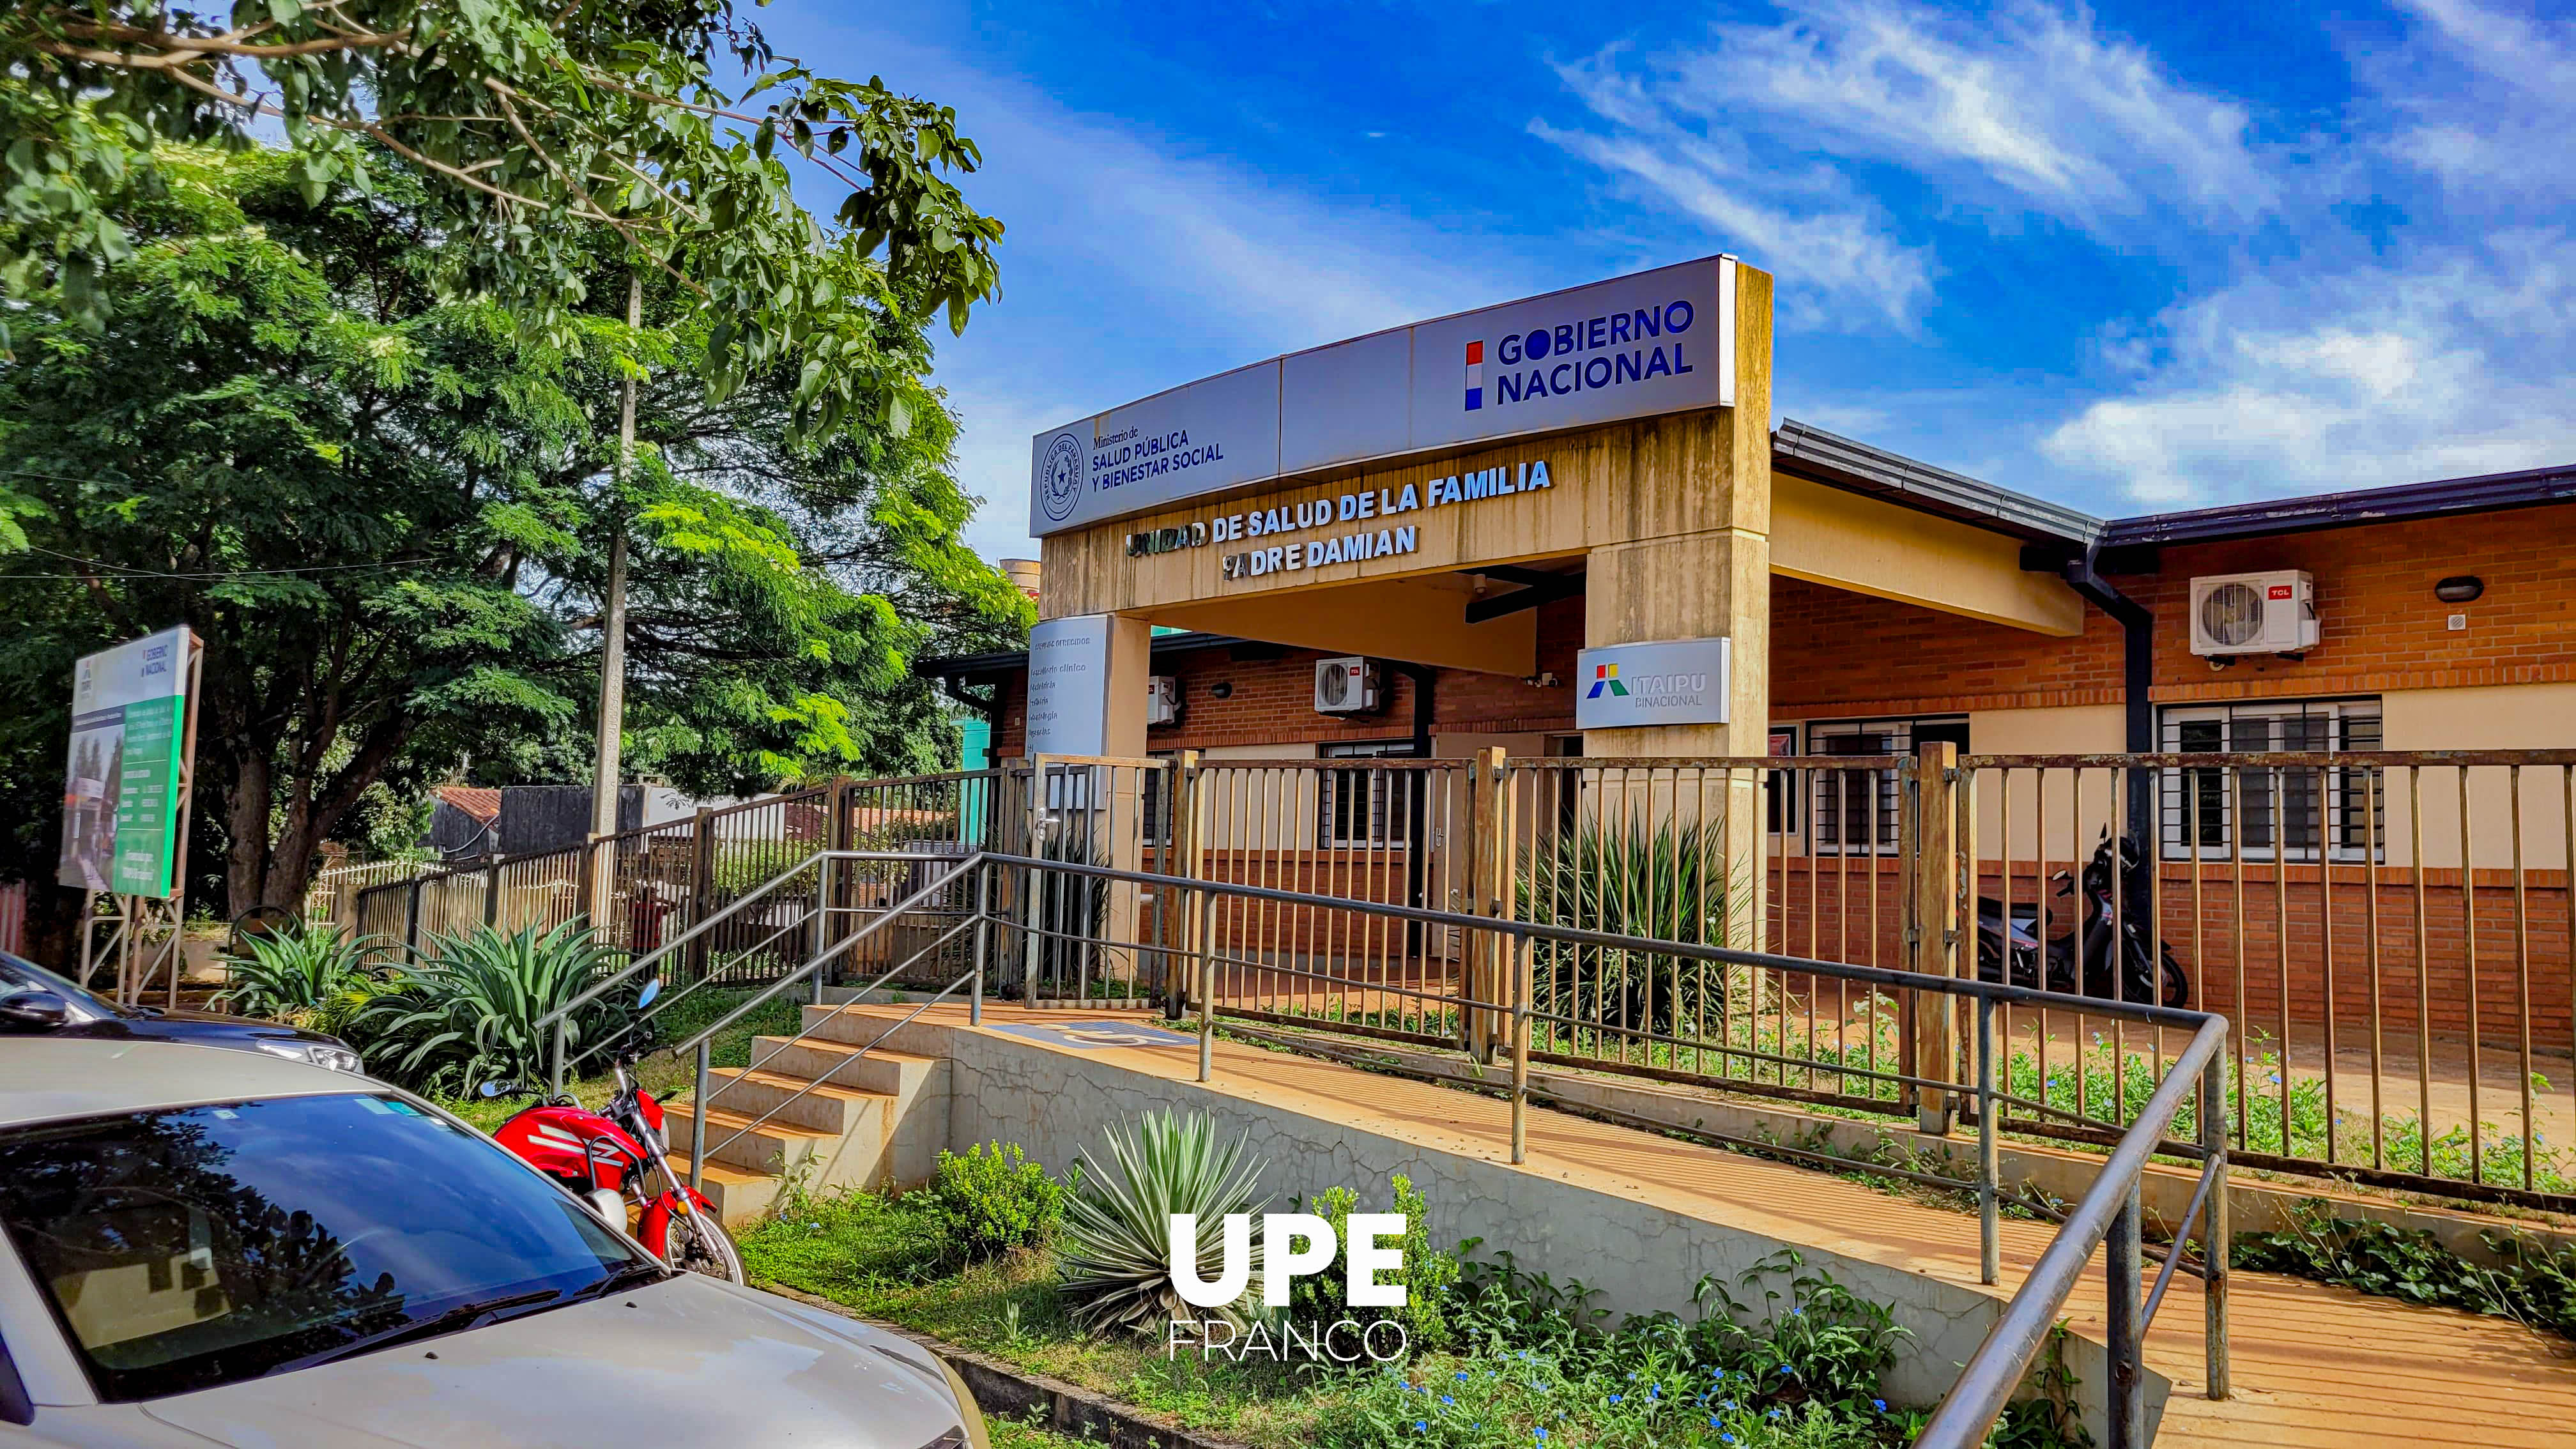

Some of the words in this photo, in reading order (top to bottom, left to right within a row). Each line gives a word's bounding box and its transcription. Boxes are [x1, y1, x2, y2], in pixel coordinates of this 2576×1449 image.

[1498, 300, 1694, 366] GOBIERNO
[1497, 342, 1693, 405] NACIONAL
[1092, 434, 1128, 451] Ministerio
[1129, 425, 1138, 439] de
[1092, 445, 1130, 472] SALUD
[1135, 429, 1189, 457] PÚBLICA
[1092, 477, 1099, 493] Y
[1102, 457, 1169, 490] BIENESTAR
[1172, 444, 1223, 471] SOCIAL
[1126, 521, 1209, 557] UNIDAD
[1213, 514, 1243, 543] DE
[1246, 499, 1332, 537] SALUD
[1340, 493, 1374, 522] DE
[1382, 484, 1418, 516] LA
[1427, 460, 1551, 507] FAMILIA
[1222, 542, 1301, 581] PADRE
[1307, 525, 1416, 567] DAMIAN
[1631, 673, 1707, 695] ITAIPU
[1635, 696, 1703, 709] BINACIONAL
